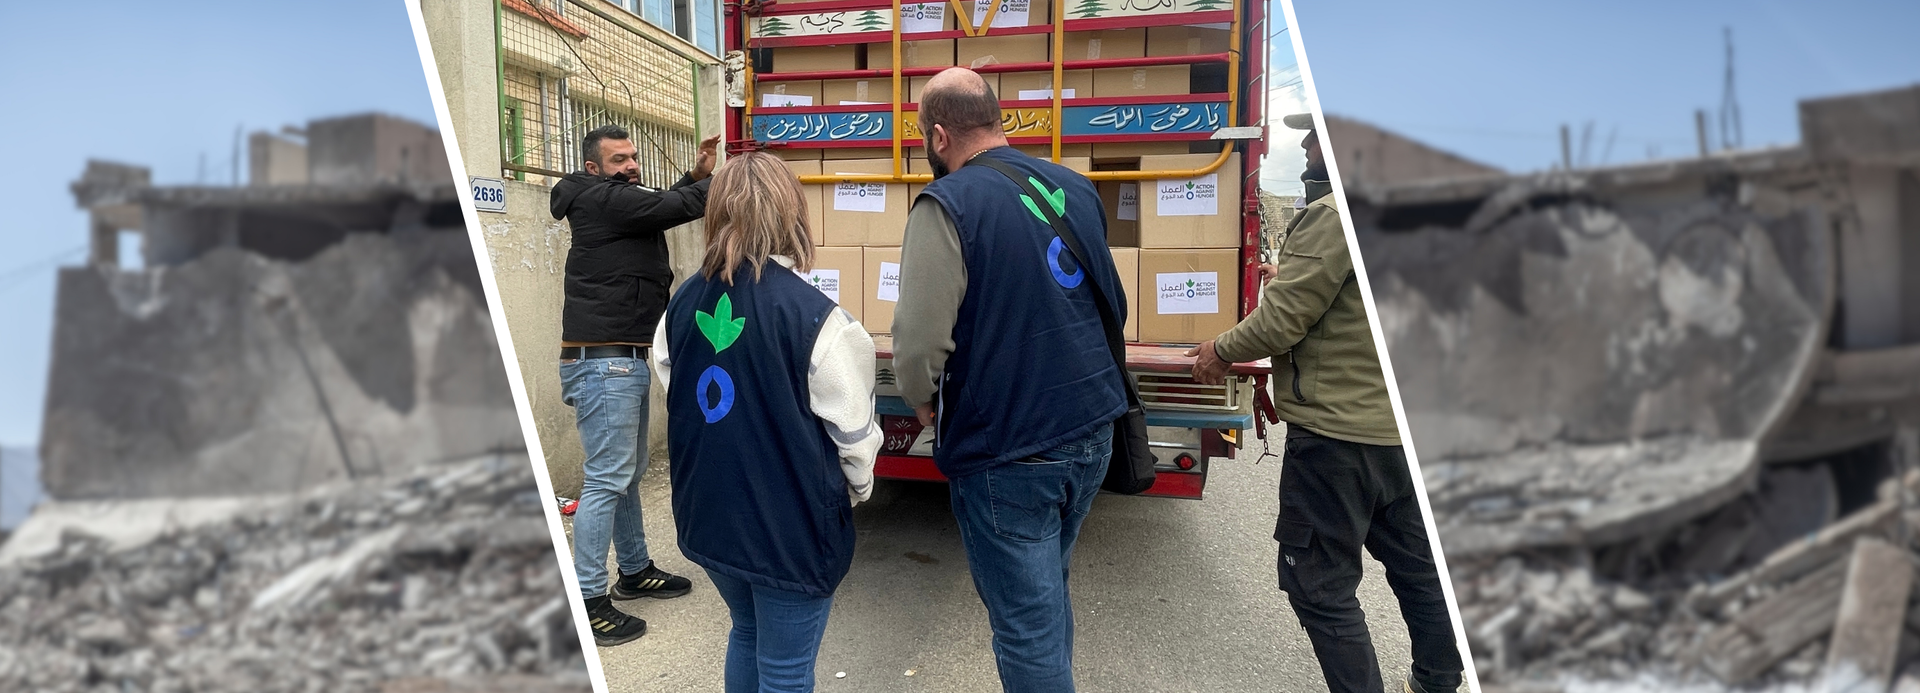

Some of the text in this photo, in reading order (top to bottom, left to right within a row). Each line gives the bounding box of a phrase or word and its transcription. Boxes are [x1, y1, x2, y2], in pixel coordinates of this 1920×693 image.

[1088, 107, 1143, 130] الله
[474, 186, 503, 203] 2636
[1161, 185, 1185, 194] العمل
[1161, 283, 1185, 292] العمل
